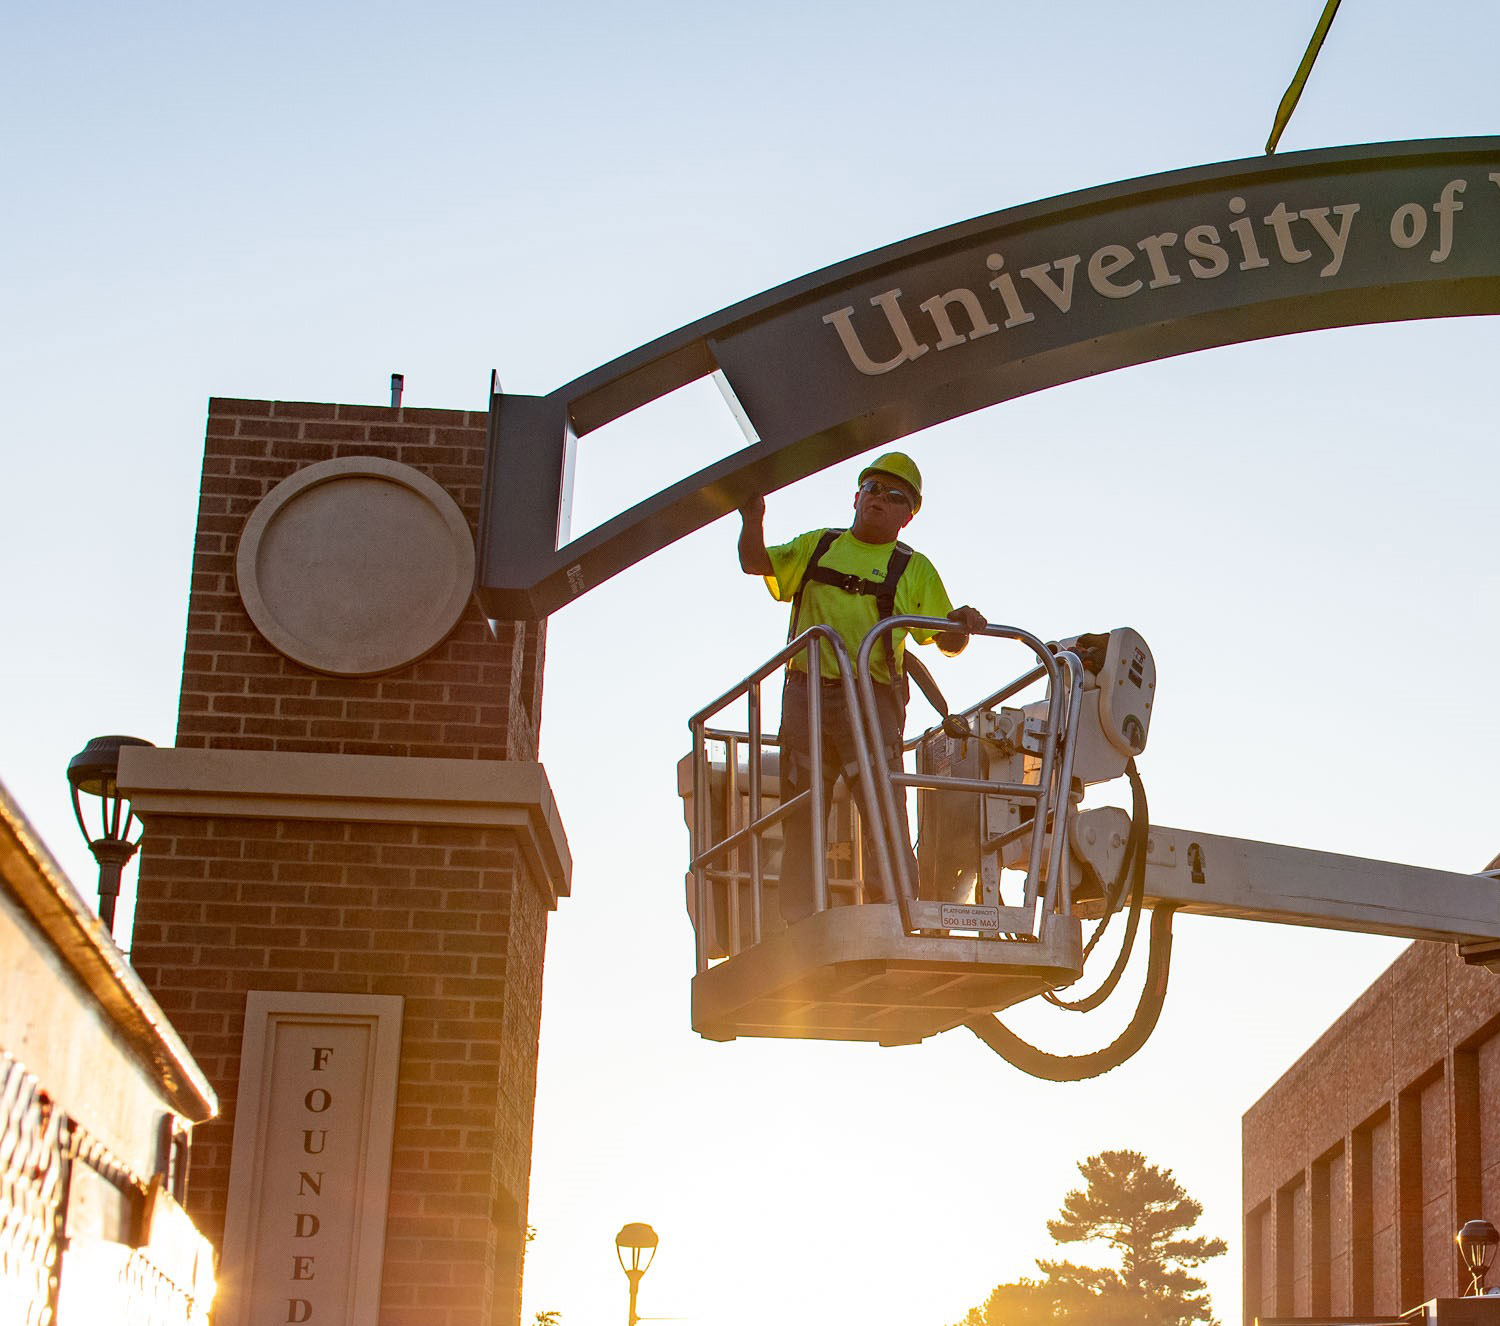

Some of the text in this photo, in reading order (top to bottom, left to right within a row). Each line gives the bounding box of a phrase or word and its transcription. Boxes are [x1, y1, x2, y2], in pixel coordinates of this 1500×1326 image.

[822, 196, 1361, 376] University
[1390, 179, 1467, 263] of
[285, 1047, 334, 1324] FOUNDED
